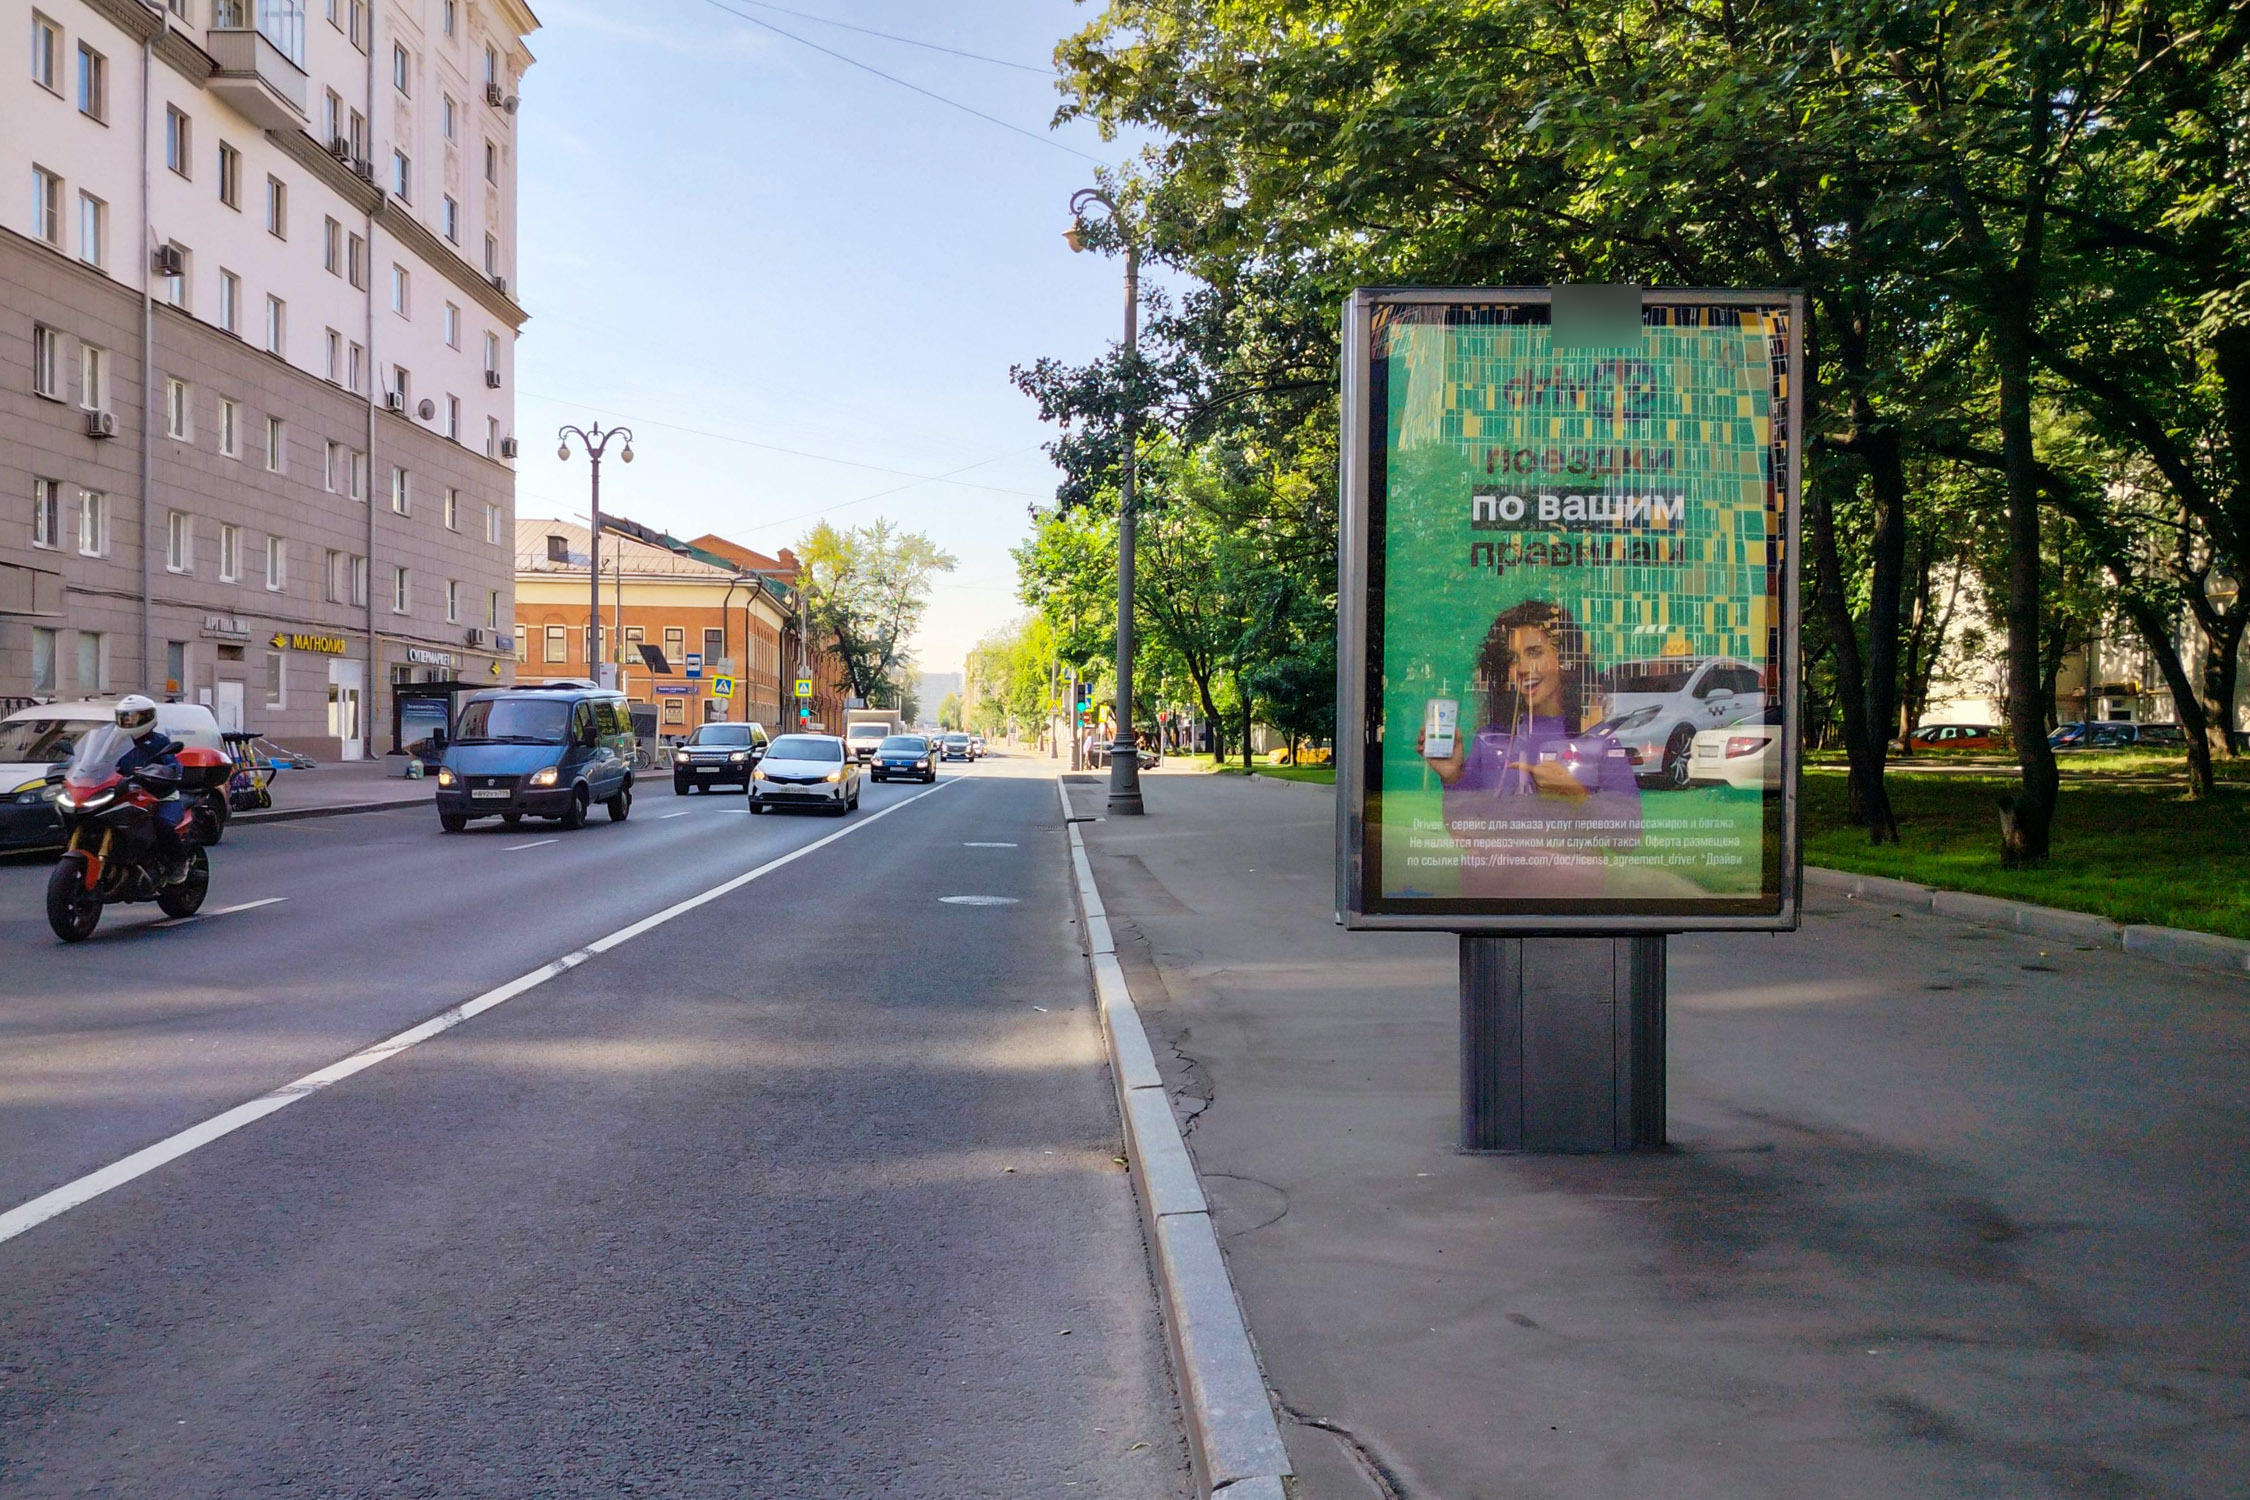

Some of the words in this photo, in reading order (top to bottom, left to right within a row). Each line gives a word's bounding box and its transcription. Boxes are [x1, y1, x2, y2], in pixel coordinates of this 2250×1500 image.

[1486, 448, 1672, 480] поездки
[1472, 495, 1525, 521] по
[1538, 495, 1685, 521] вашим
[1470, 541, 1685, 576] правилам
[293, 634, 346, 654] МАГНОЛИЯ
[409, 648, 450, 666] СУПЕРМАРКЕТ
[1451, 820, 1486, 832] сервис
[1488, 819, 1508, 831] для
[1509, 820, 1543, 830] заказа
[1546, 819, 1572, 832] услуг
[1575, 819, 1627, 831] перевозки
[1629, 819, 1689, 831] пассажиров
[1690, 819, 1697, 829] и
[1410, 837, 1422, 848] Не
[1424, 838, 1471, 848] является
[1473, 838, 1544, 850] перевозчиком
[1546, 837, 1565, 847] или
[1567, 835, 1610, 850] службой
[1645, 836, 1682, 849] Оферта
[1407, 855, 1419, 866] по
[1421, 855, 1458, 866] ссылке
